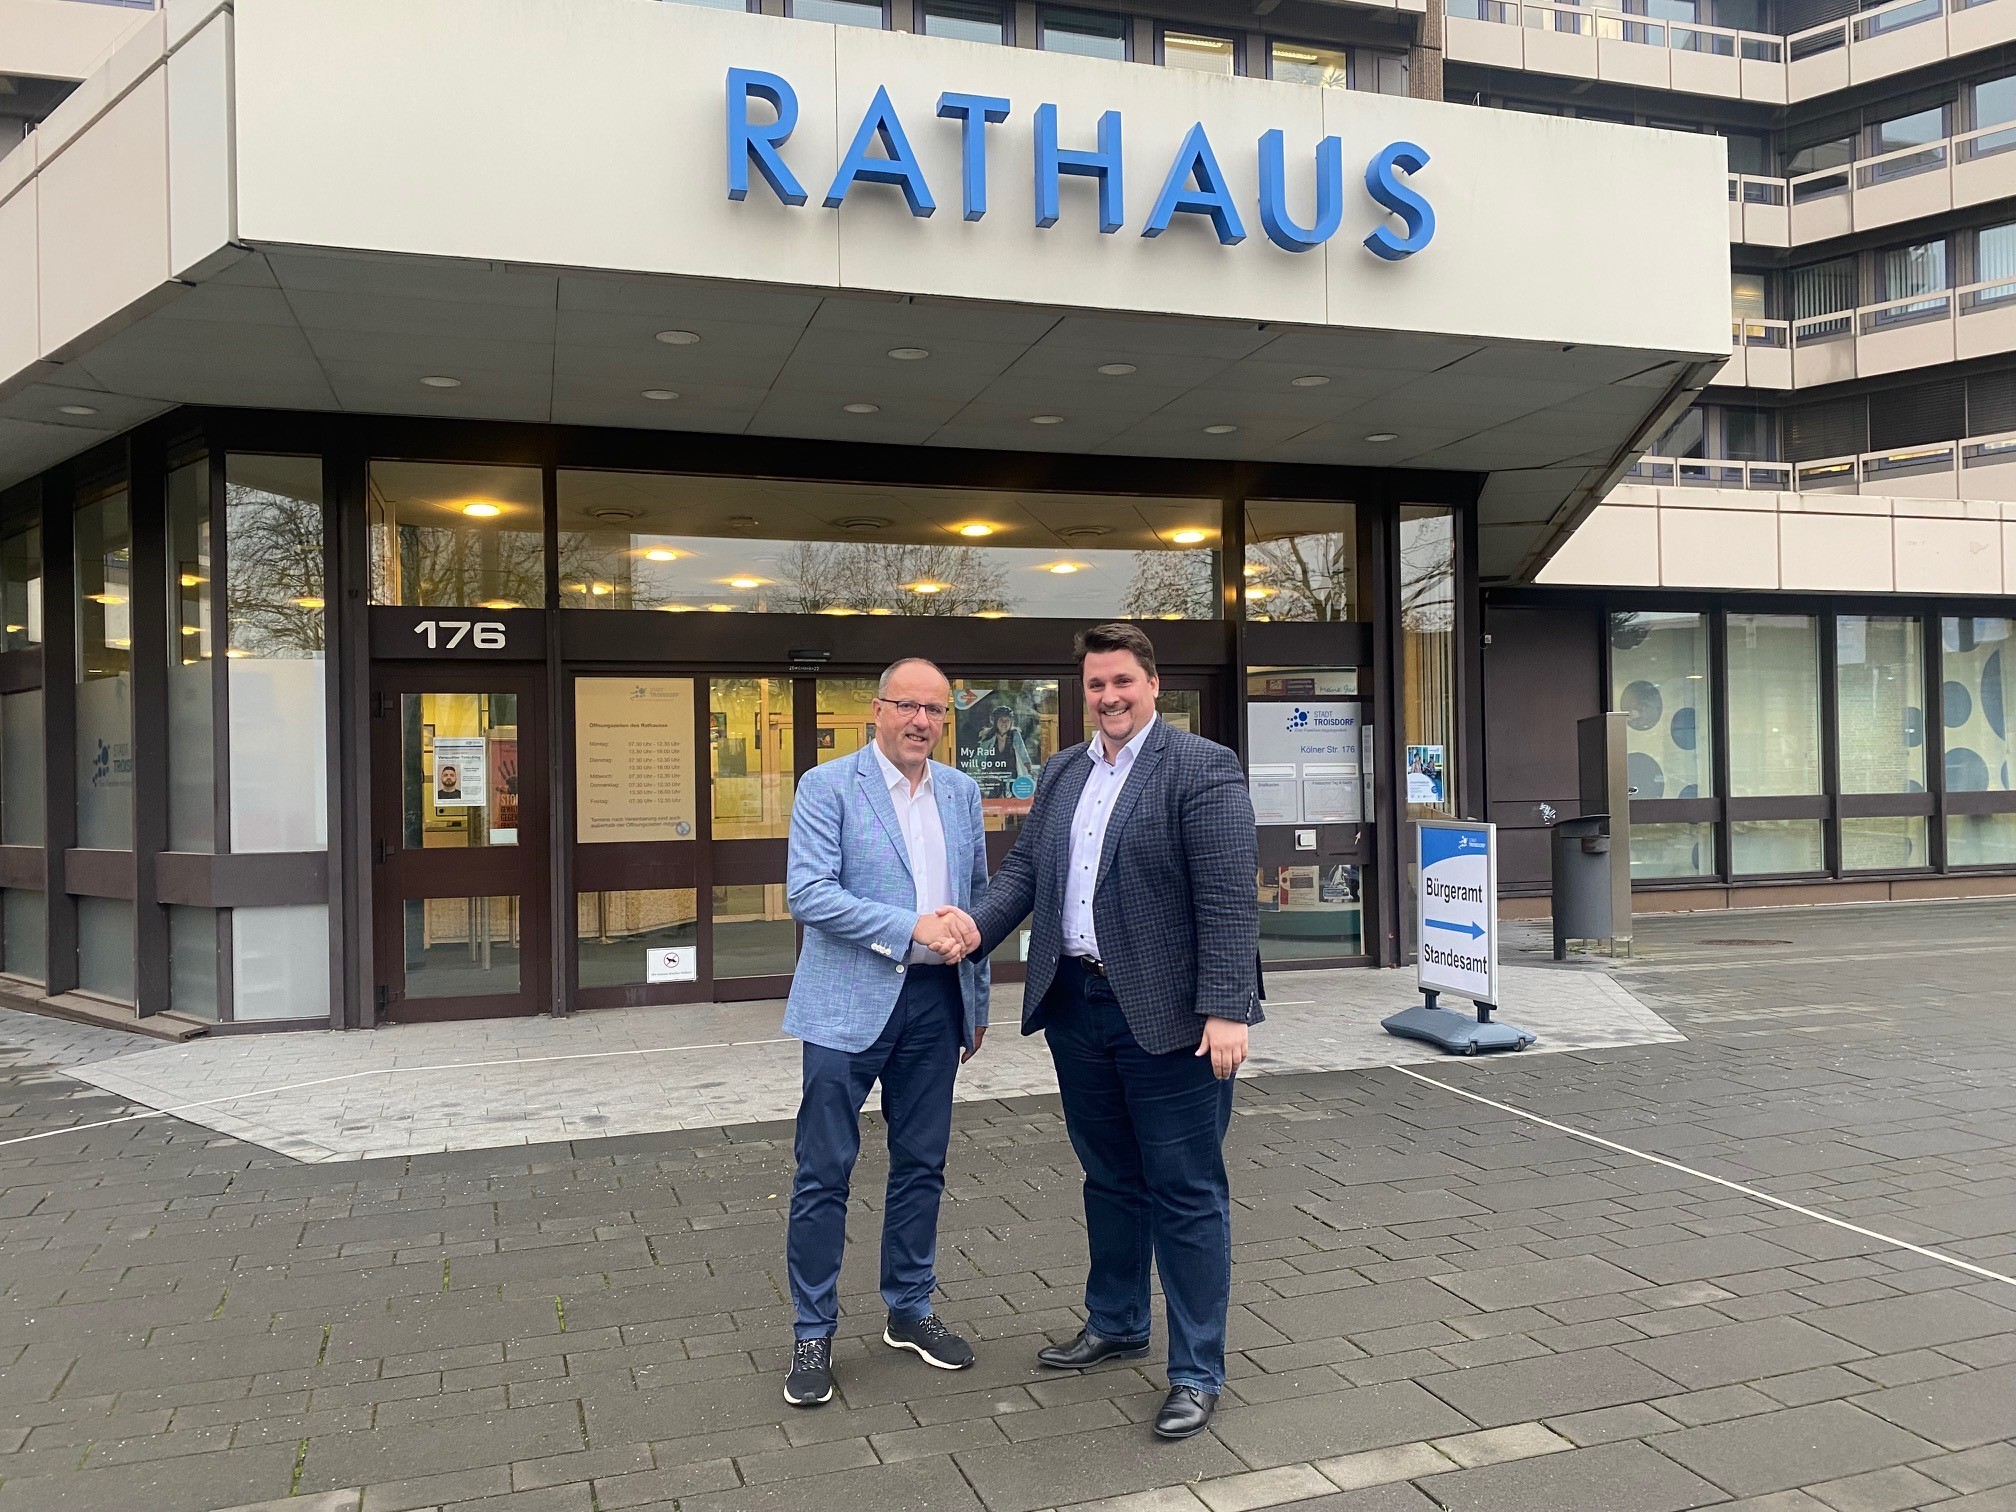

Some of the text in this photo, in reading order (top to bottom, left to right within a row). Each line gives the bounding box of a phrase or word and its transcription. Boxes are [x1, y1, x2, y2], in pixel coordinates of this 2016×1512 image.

[725, 66, 1436, 261] RATHAUS
[413, 621, 506, 649] 176
[1313, 710, 1333, 718] STADT
[1313, 718, 1355, 726] TROISDORF
[960, 747, 996, 759] My Rad
[1300, 745, 1356, 754] Kölner Str. 176
[960, 760, 979, 768] will
[981, 761, 993, 770] go
[1426, 877, 1483, 904] Bürgeramt
[1424, 943, 1488, 975] Standesamt
